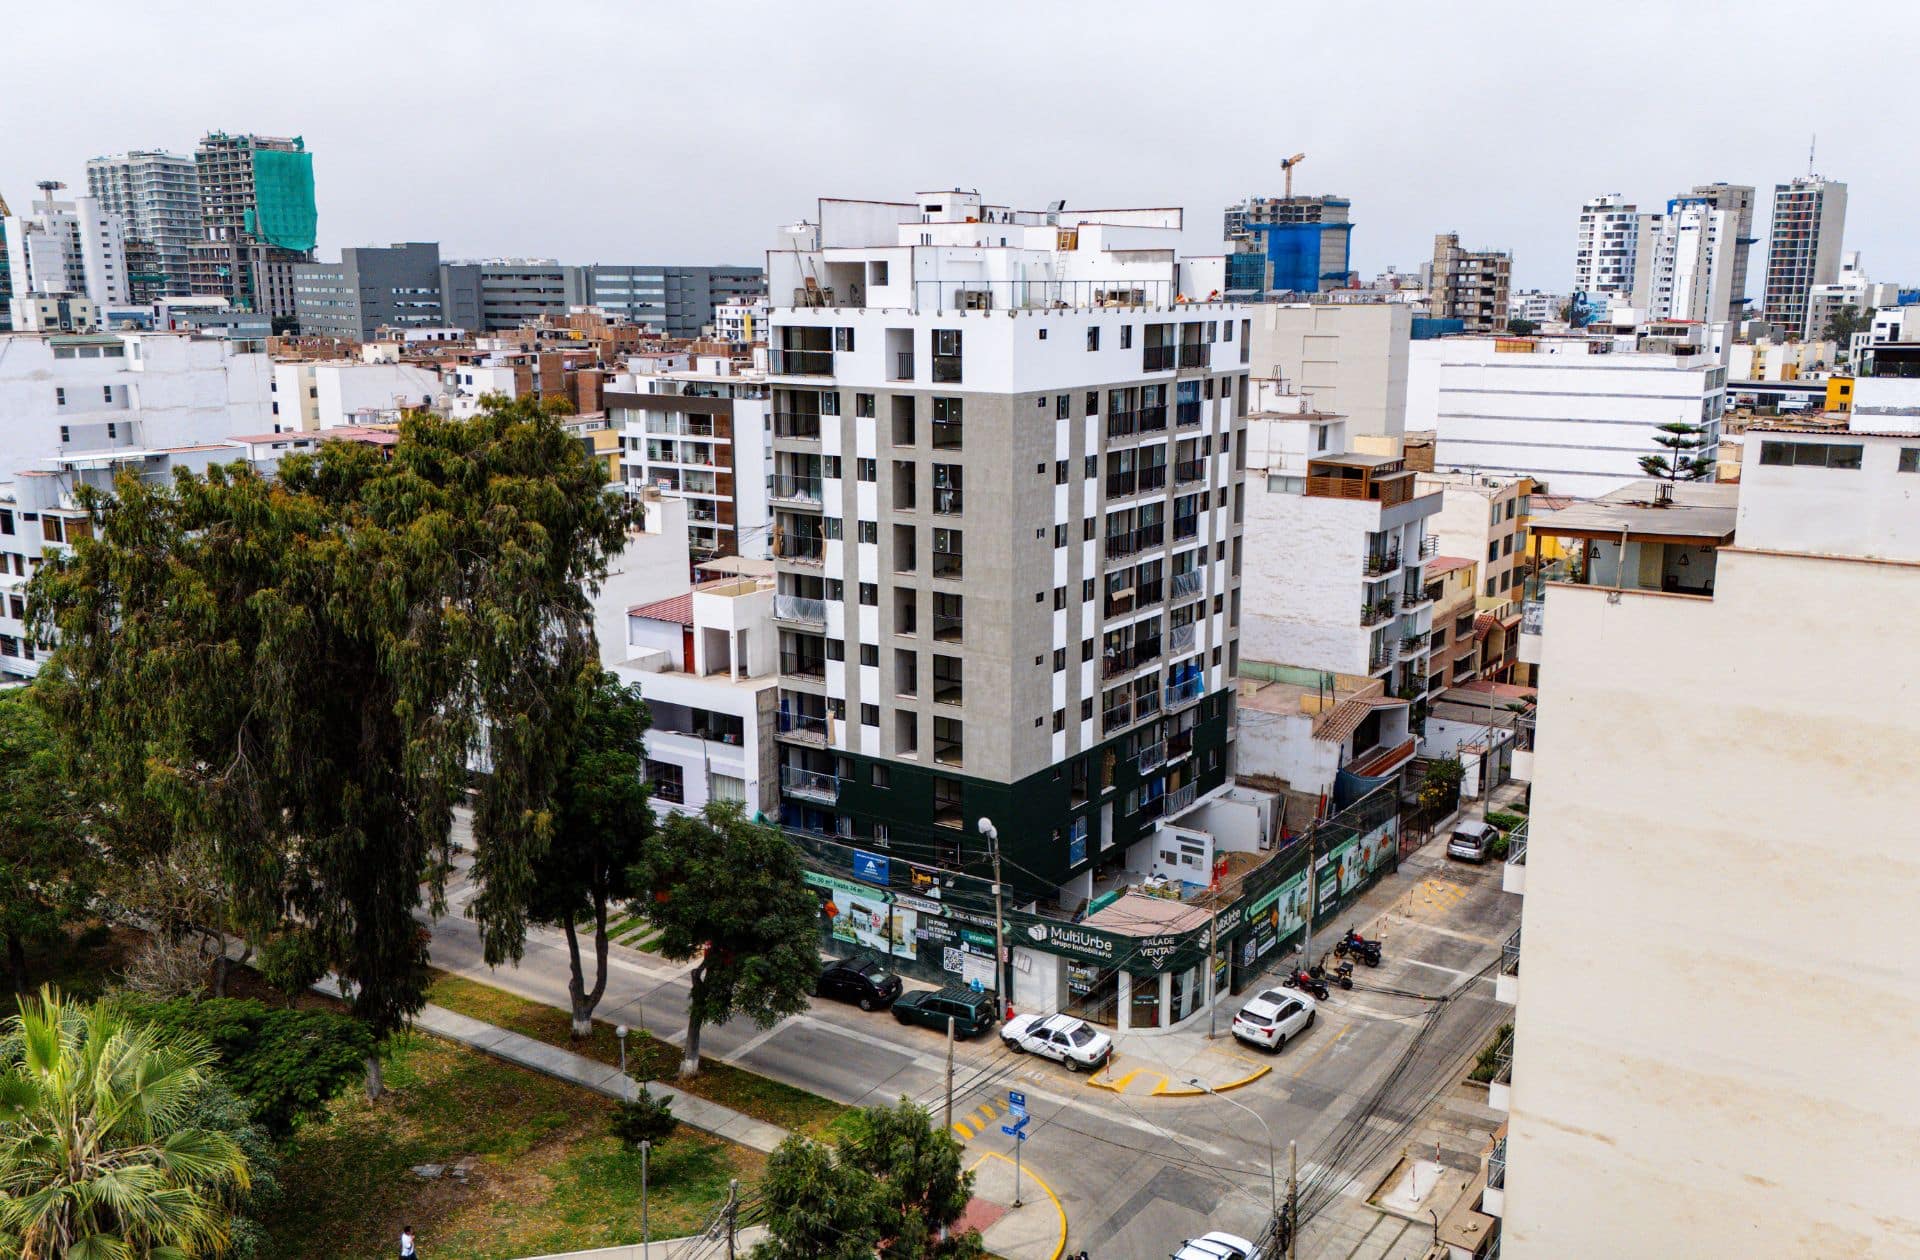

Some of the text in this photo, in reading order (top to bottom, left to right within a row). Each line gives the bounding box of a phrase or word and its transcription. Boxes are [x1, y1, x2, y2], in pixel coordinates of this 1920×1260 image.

[1051, 926, 1113, 951] MultiUrbe
[1142, 937, 1175, 947] SALA DE
[1051, 938, 1112, 959] Grupo Inmobiliario
[1140, 945, 1177, 957] VENTAS
